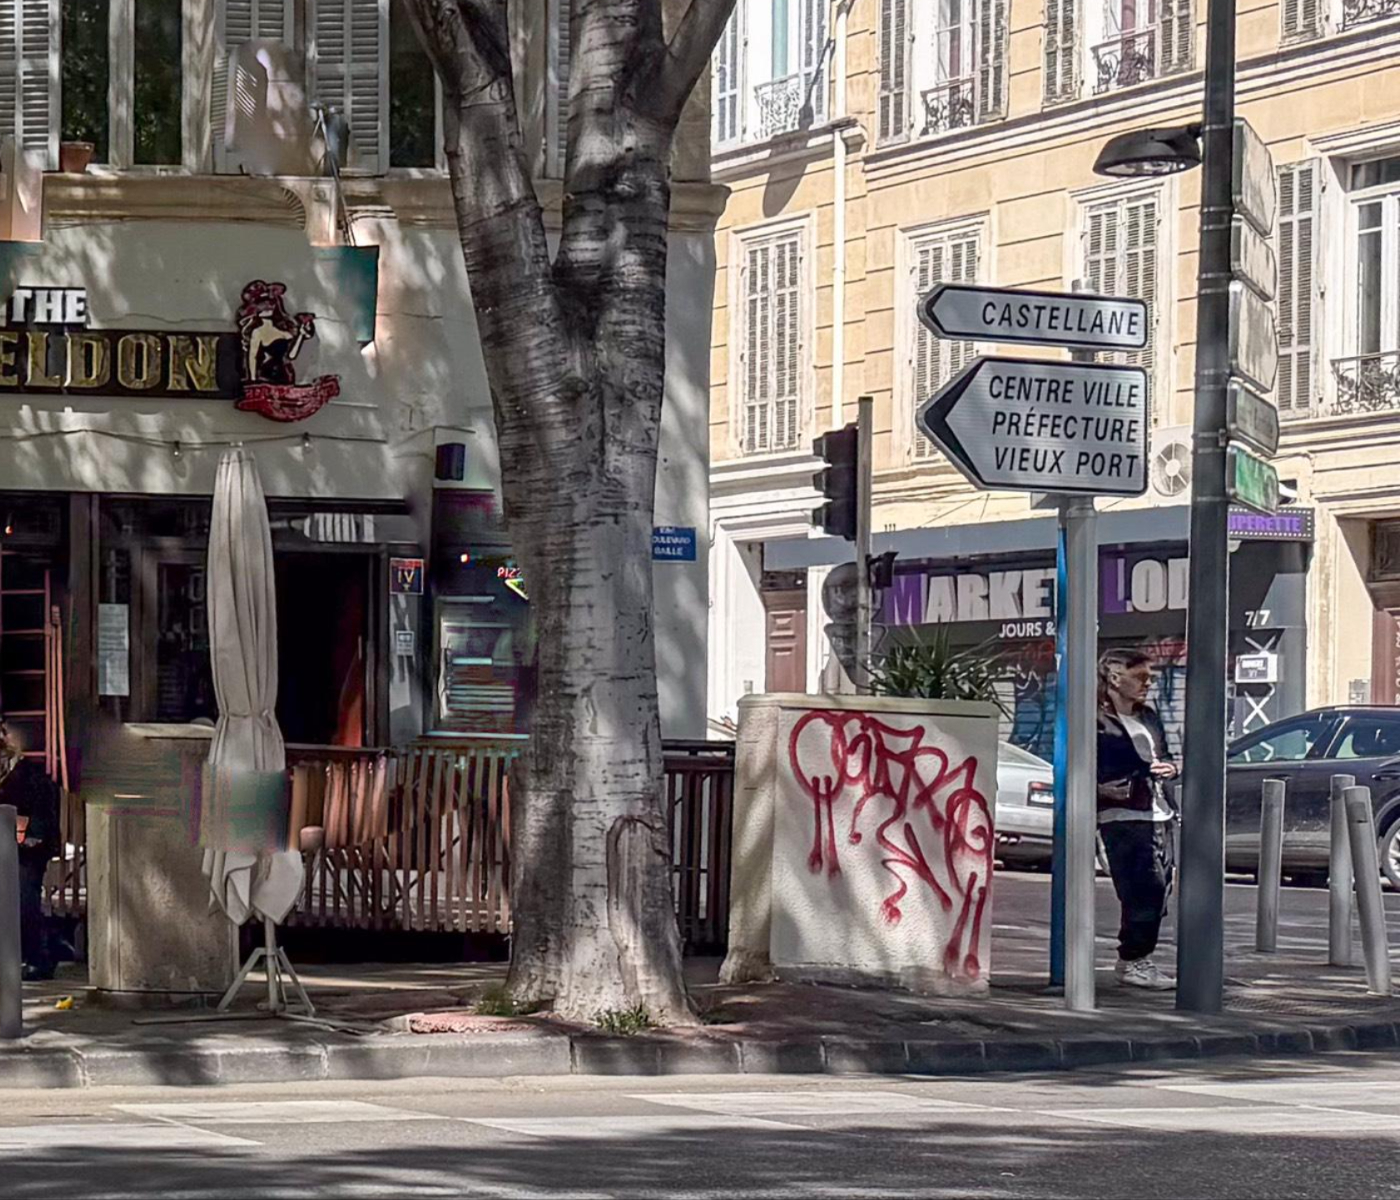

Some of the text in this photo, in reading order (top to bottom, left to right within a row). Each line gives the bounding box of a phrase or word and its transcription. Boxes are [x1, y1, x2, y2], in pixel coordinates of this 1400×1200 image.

[10, 287, 87, 325] THE
[981, 301, 1139, 336] CASTELLANE
[988, 374, 1139, 408] CENTRE VILLE
[992, 406, 1139, 443] PRÉFECTURE
[994, 446, 1139, 478] VIEUX PORT
[652, 535, 691, 544] OULEVARD
[1230, 514, 1301, 532] UPERETTE
[497, 566, 522, 578] PIZ
[1102, 557, 1189, 613] LOD
[998, 609, 1272, 638] JOURS & 7/7
